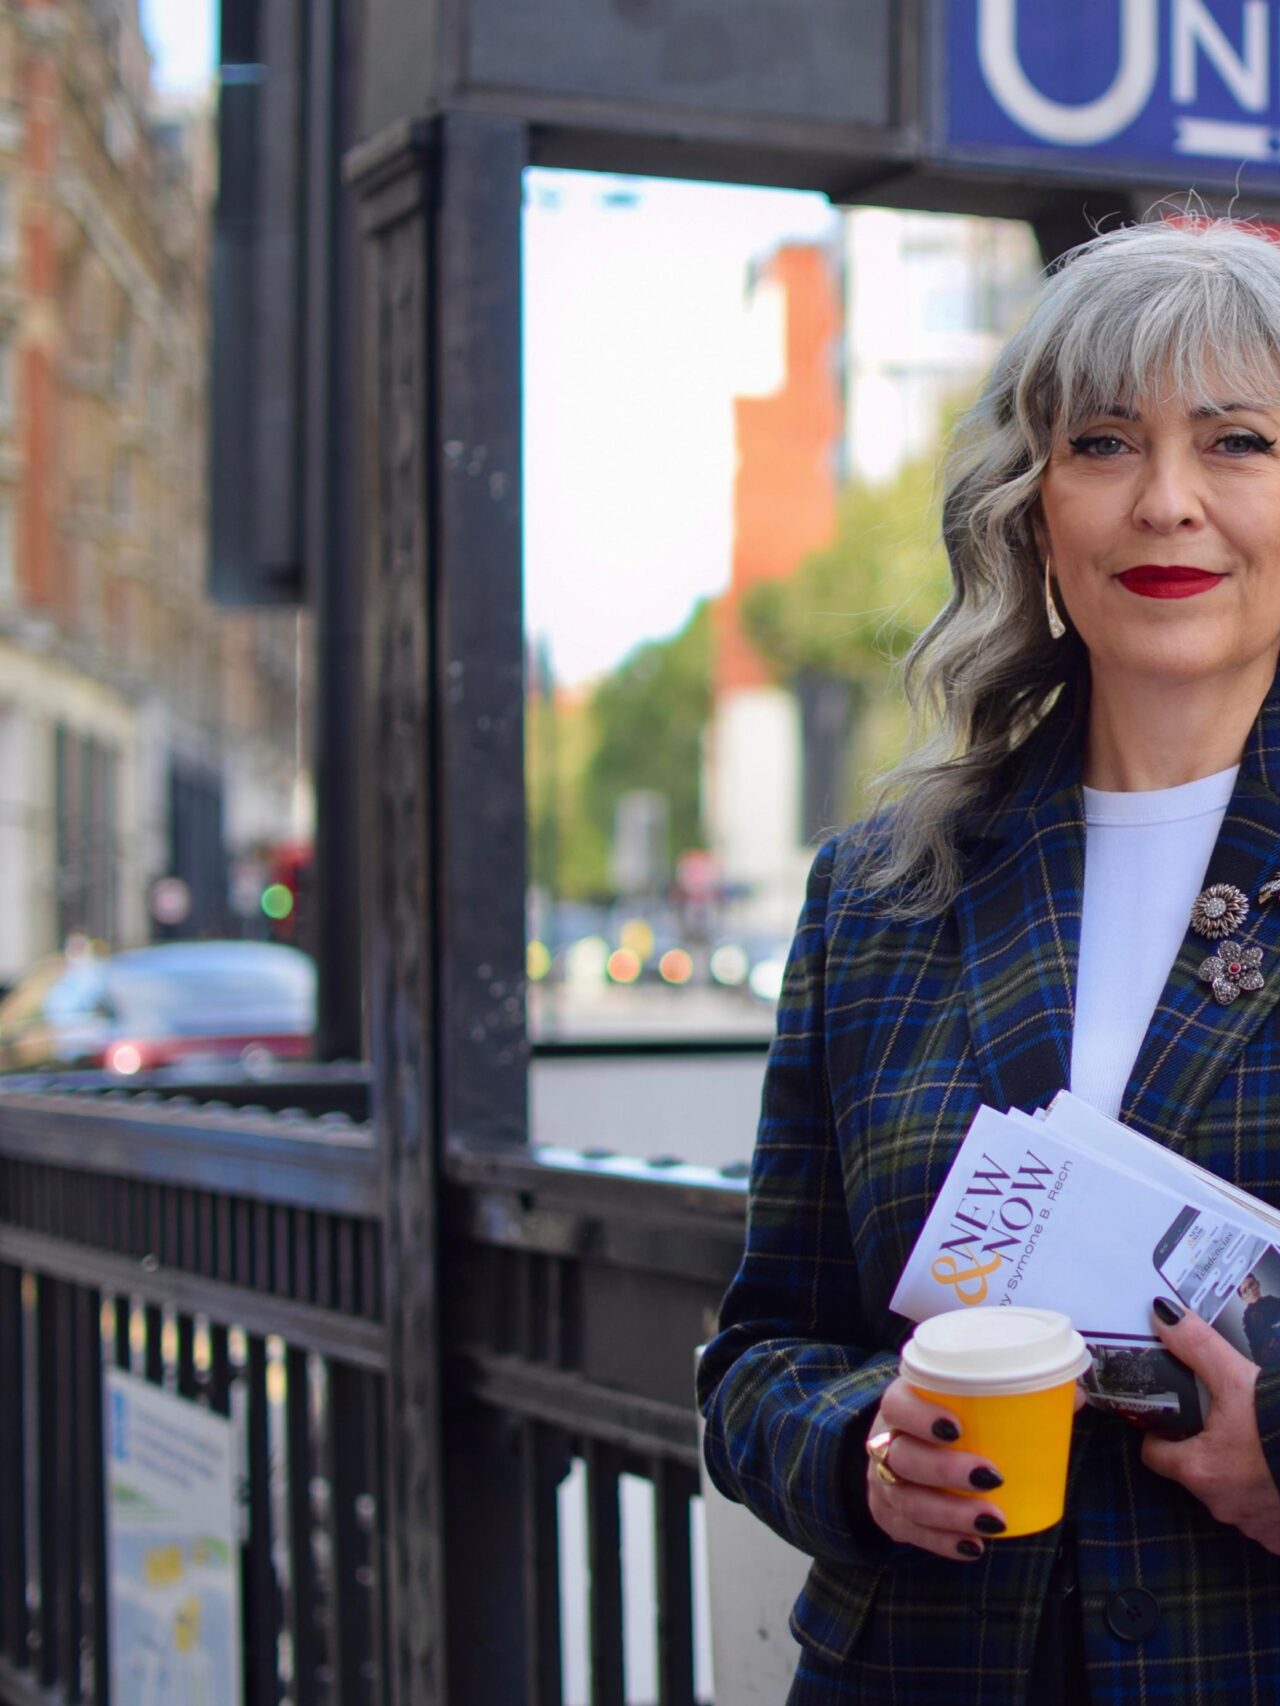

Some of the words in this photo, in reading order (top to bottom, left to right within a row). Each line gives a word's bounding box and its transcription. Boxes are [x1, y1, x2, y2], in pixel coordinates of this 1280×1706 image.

[939, 1152, 1011, 1262] NEW
[980, 1149, 1054, 1263] NOW
[1040, 1207, 1053, 1220] B.
[1047, 1159, 1073, 1202] Rech
[930, 1243, 1002, 1306] &
